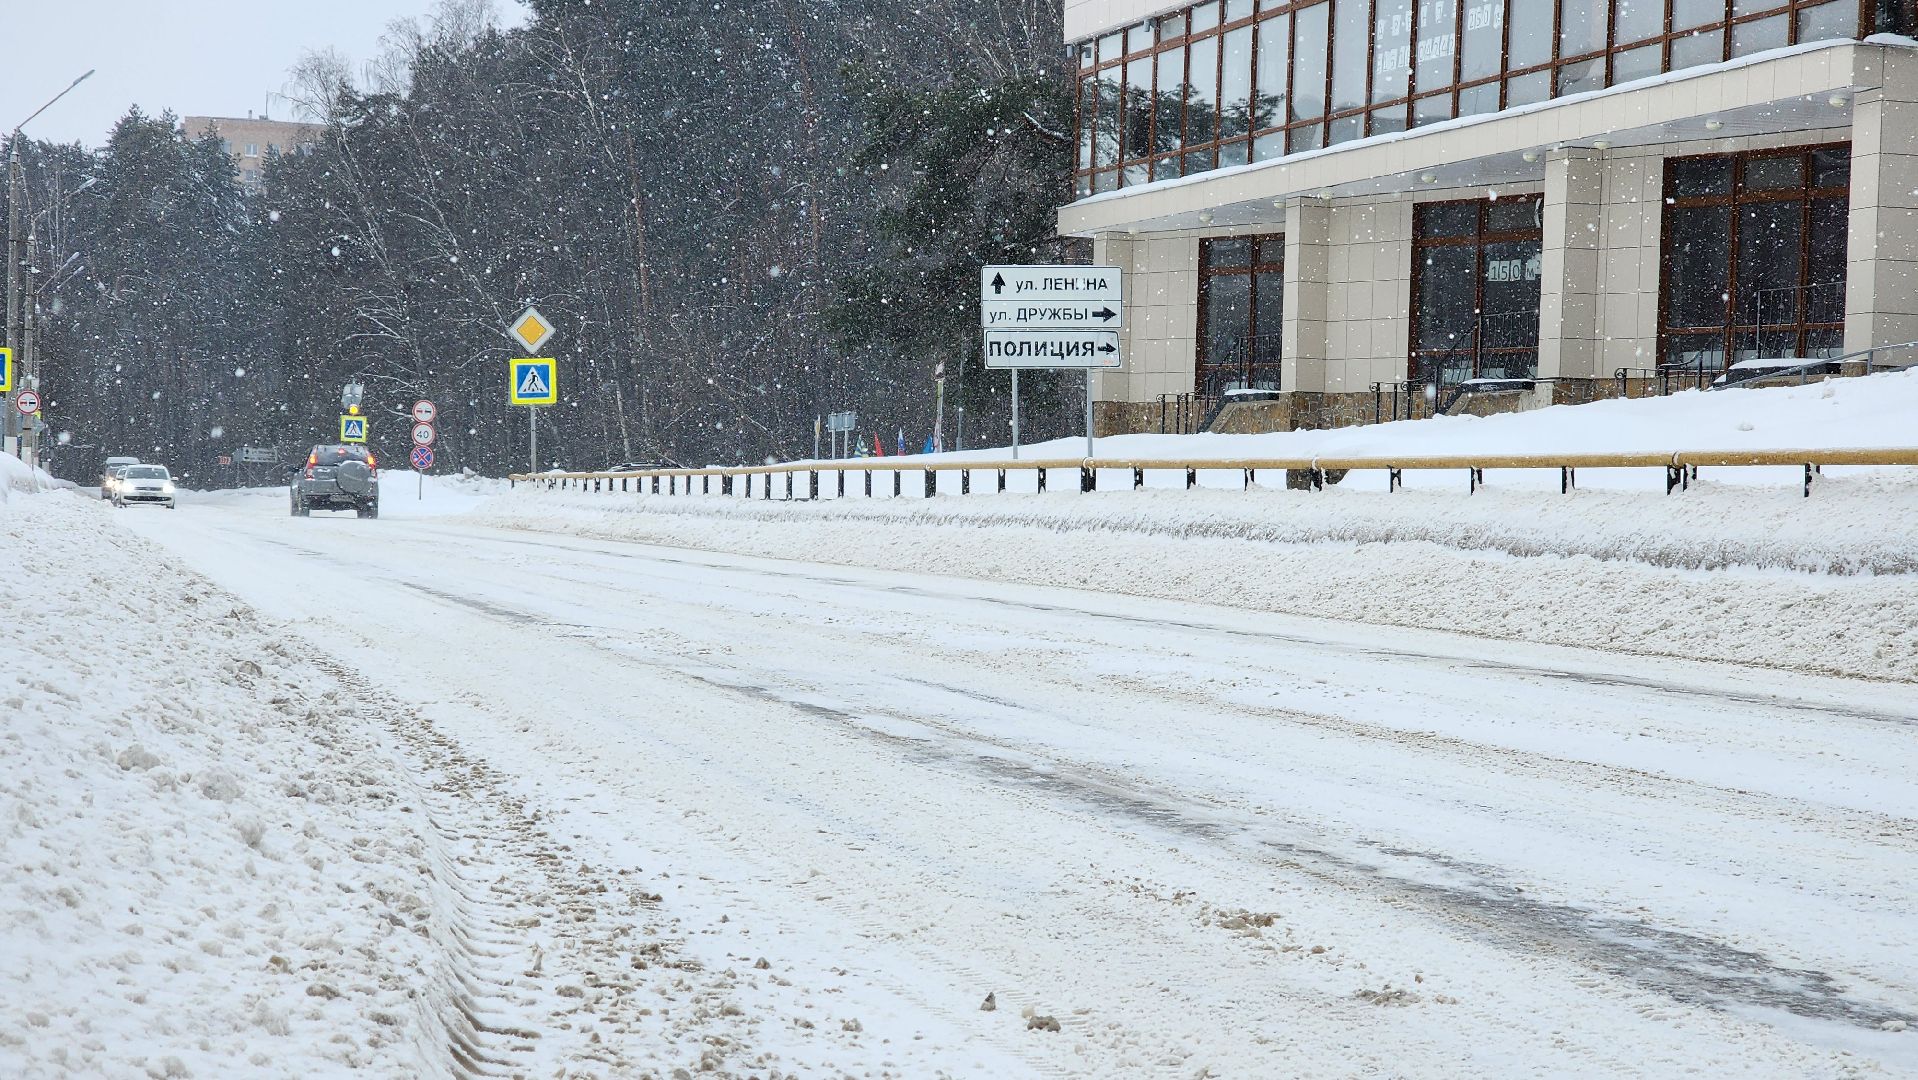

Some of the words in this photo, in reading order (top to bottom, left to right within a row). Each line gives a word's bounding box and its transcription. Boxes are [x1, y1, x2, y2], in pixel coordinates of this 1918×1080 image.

[1490, 265, 1520, 280] 150
[1016, 279, 1038, 294] ул.
[989, 311, 1012, 324] ул.
[1016, 307, 1088, 323] ДРУЖБЫ
[989, 340, 1095, 361] ПОЛИЦИЯ
[416, 431, 429, 439] 40
